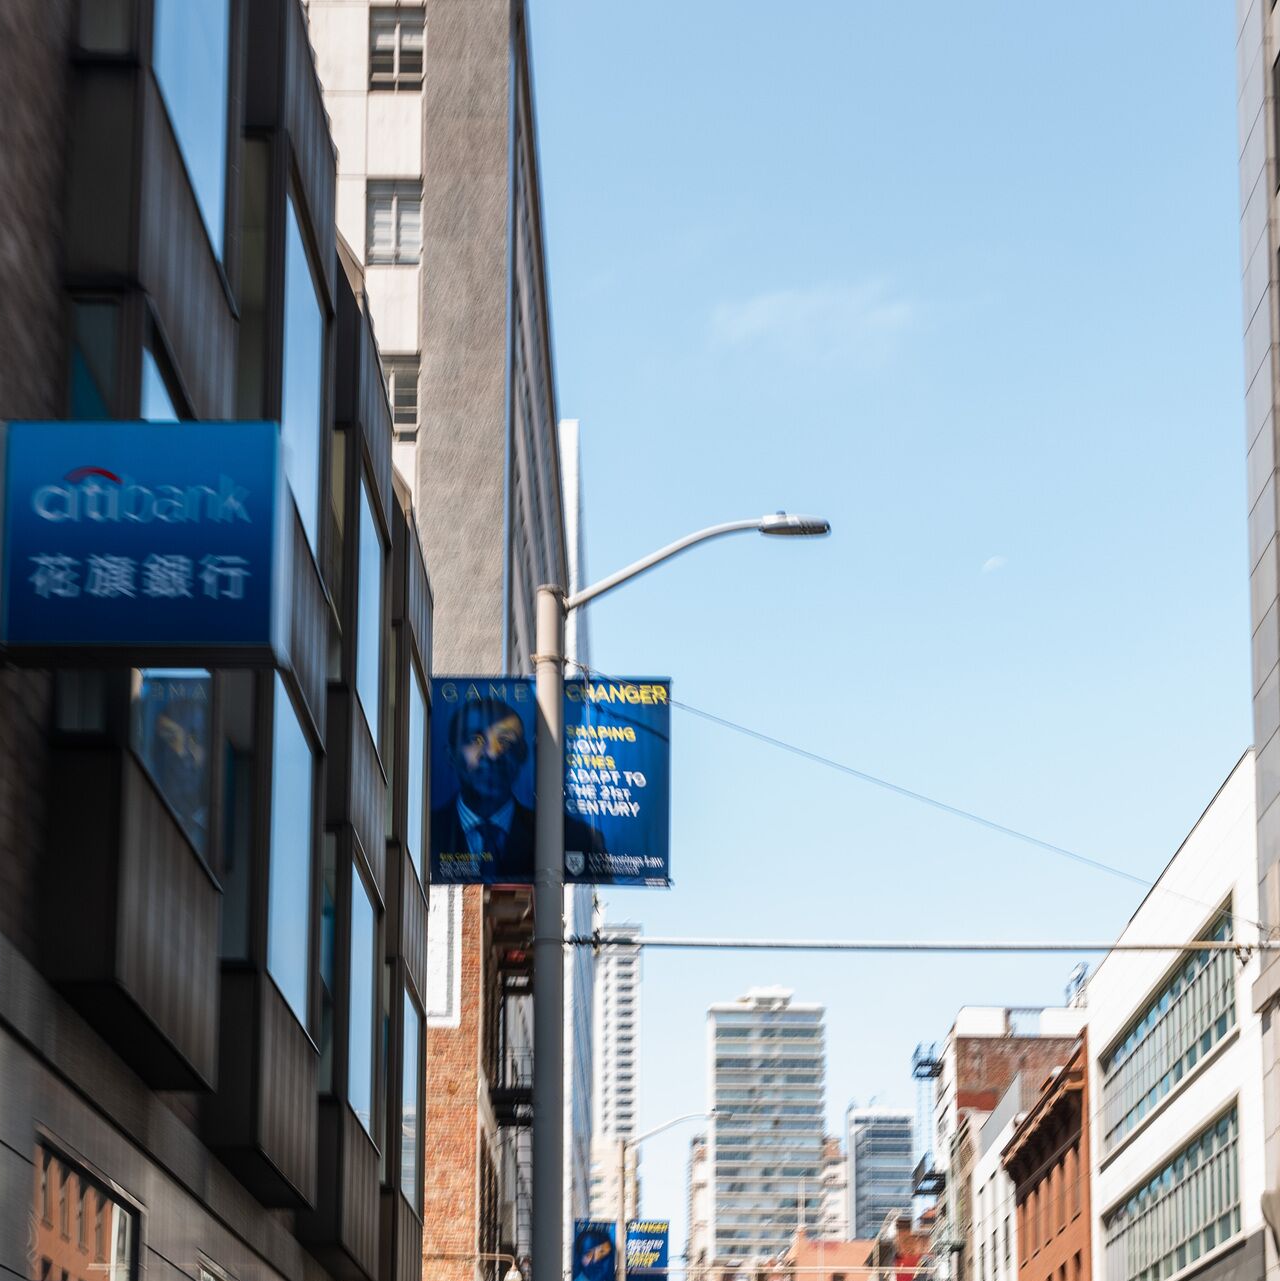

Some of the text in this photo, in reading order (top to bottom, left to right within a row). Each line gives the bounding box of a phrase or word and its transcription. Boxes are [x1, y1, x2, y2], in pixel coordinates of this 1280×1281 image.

[32, 472, 252, 523] citibank
[441, 682, 530, 703] GAME
[565, 683, 668, 705] CHANGER
[565, 723, 637, 742] SHAPING
[566, 739, 607, 755] HOW
[565, 754, 616, 770] CITIES
[567, 768, 647, 787] ADAPT TO
[566, 783, 597, 800] THE
[565, 799, 640, 818] CENTURY
